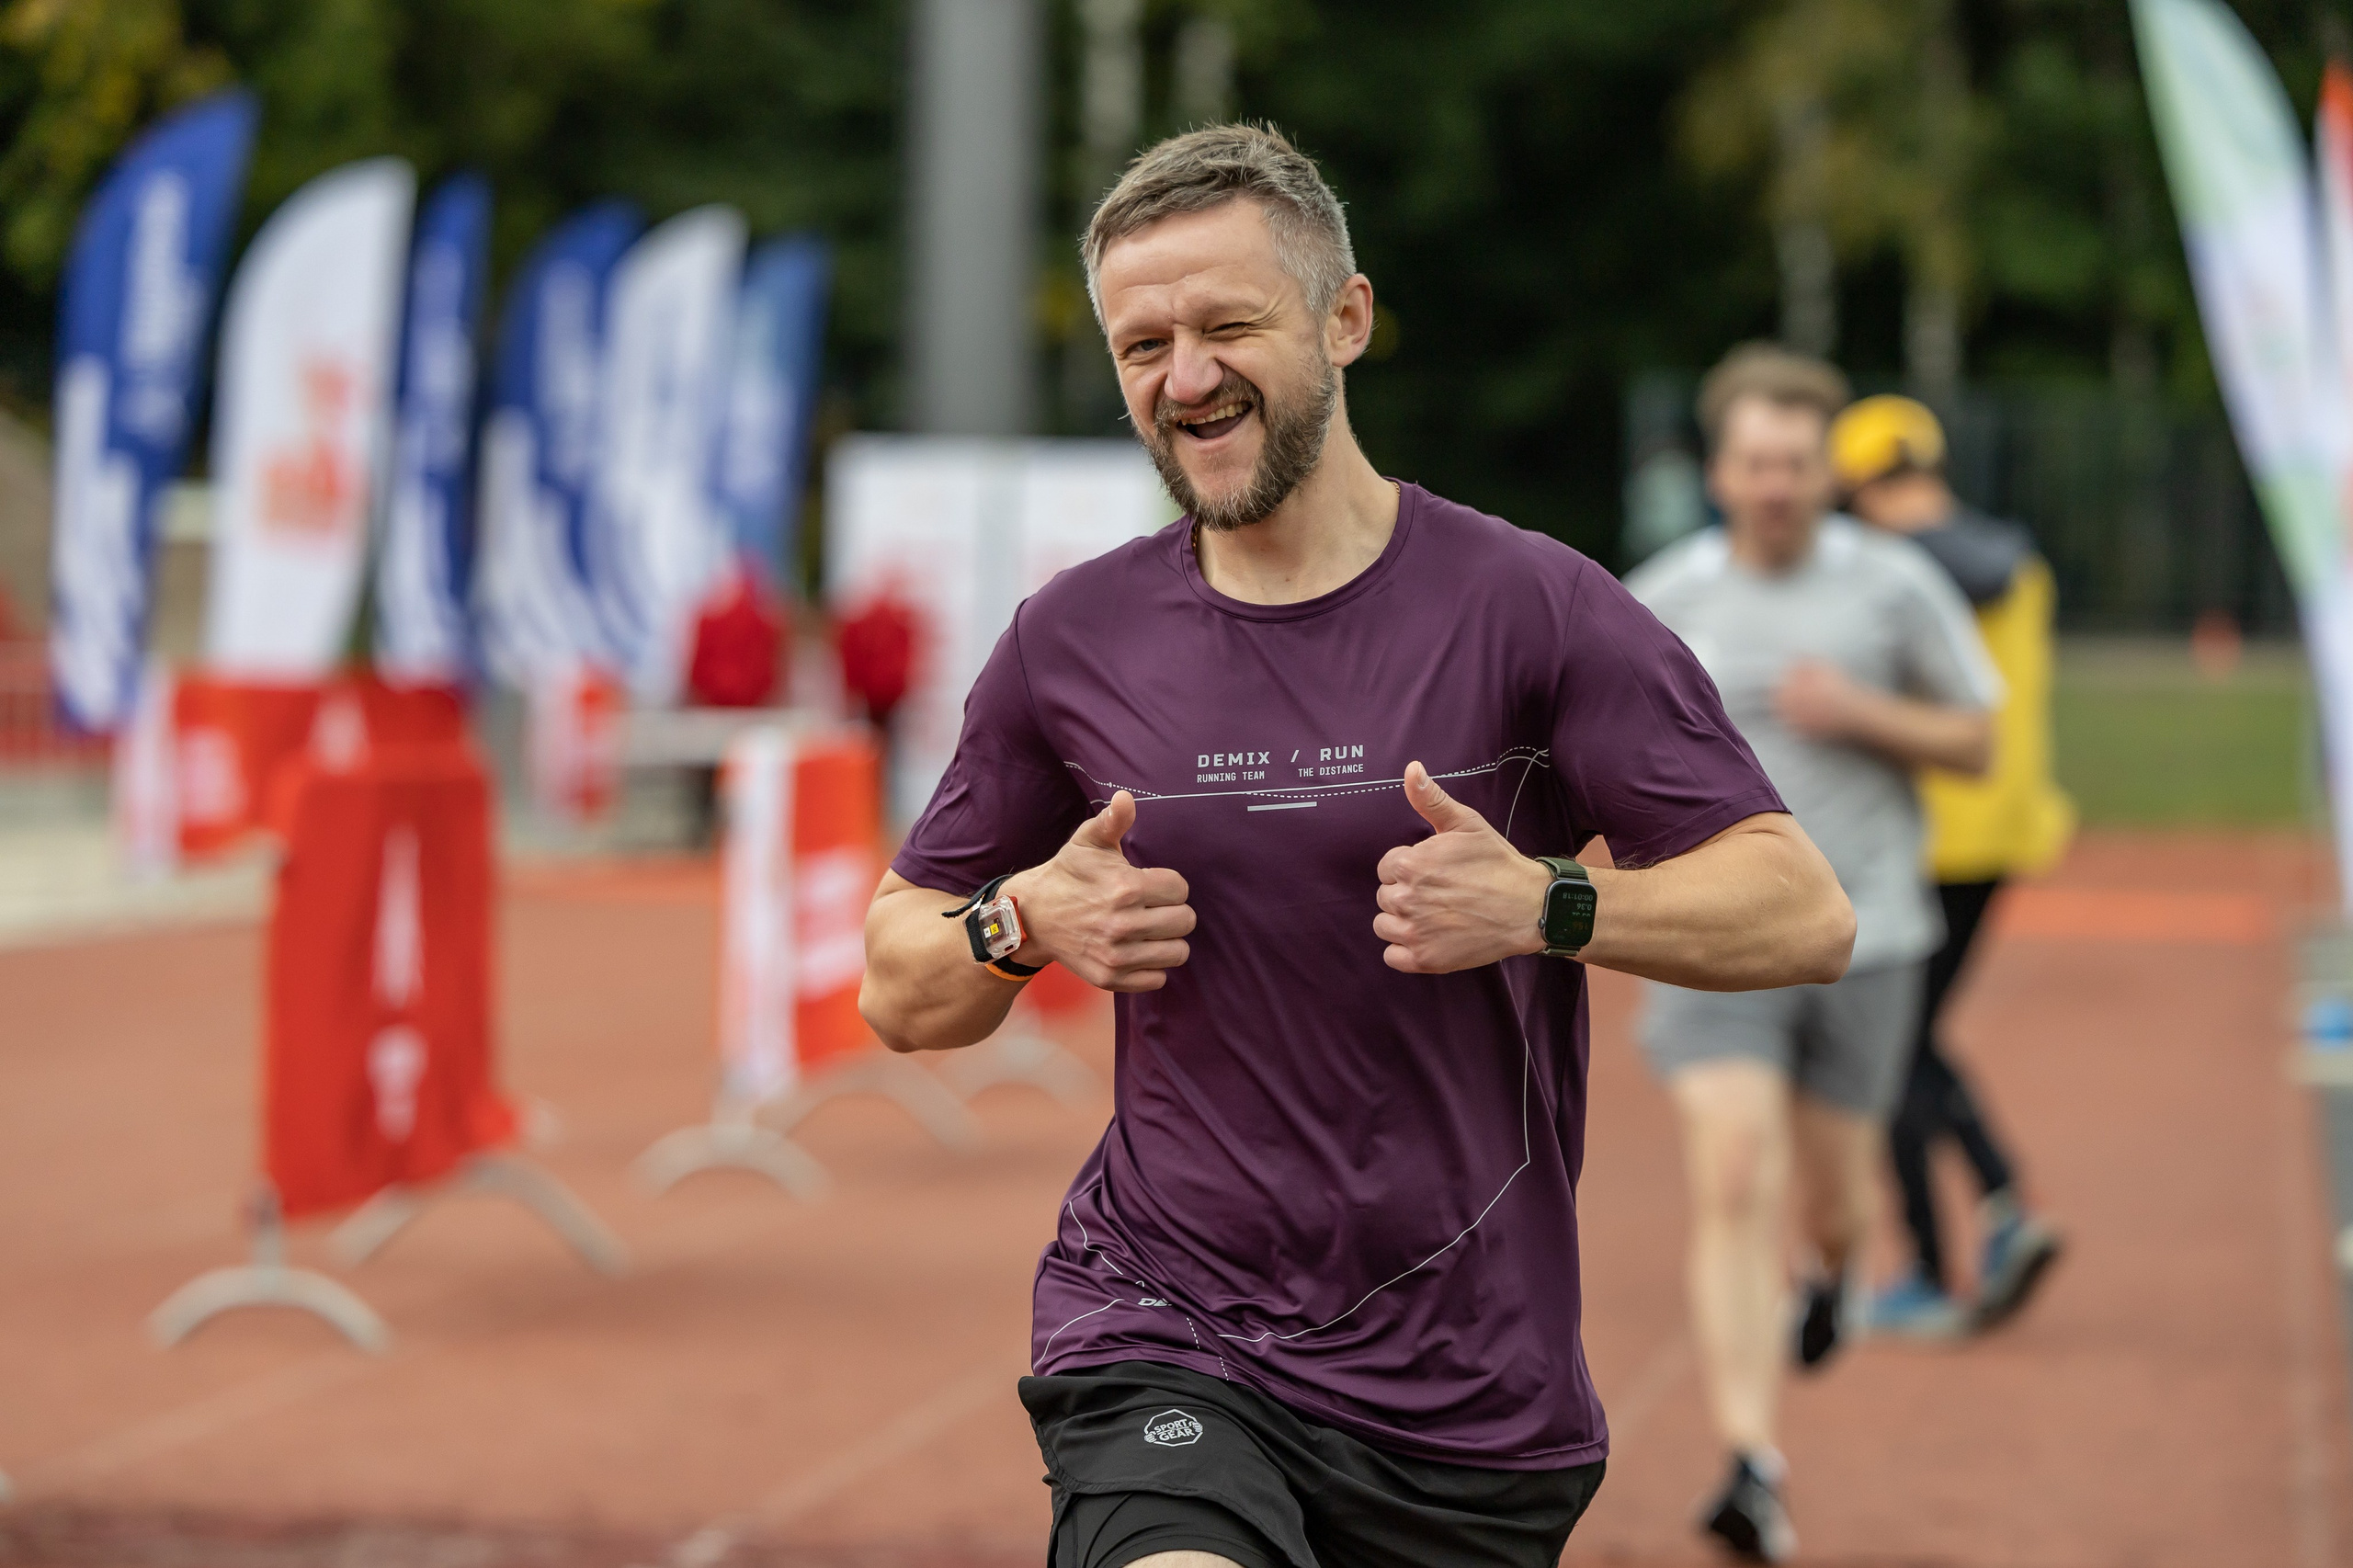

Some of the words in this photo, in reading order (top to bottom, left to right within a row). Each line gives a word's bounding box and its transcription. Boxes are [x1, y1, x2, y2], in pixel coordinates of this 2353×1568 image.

[1198, 751, 1270, 767] DEMIX
[1290, 749, 1300, 763] /
[1320, 744, 1364, 762] RUN
[1197, 772, 1236, 783] RUNNING
[1243, 770, 1265, 780] TEAM
[1298, 767, 1314, 778] THE
[1319, 763, 1364, 776] DISTANCE
[1154, 1418, 1188, 1433] SPORT
[1159, 1428, 1195, 1441] GEAR
